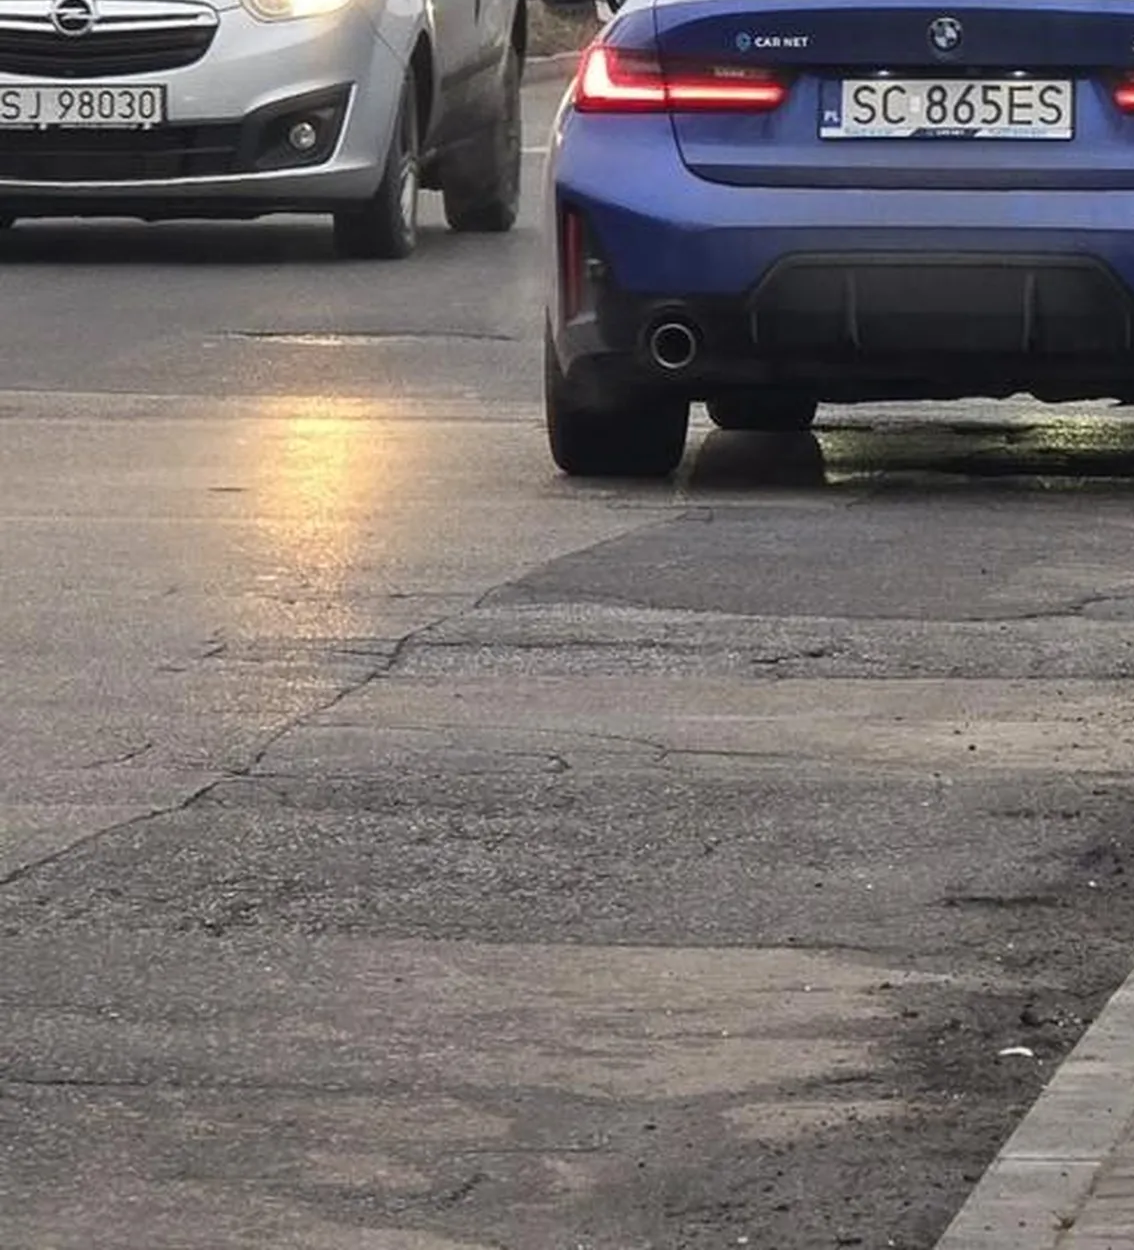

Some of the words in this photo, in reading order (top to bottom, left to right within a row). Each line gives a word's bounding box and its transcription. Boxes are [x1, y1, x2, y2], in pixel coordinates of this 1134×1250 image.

[754, 36, 780, 47] CAR
[783, 36, 808, 47] NET
[1, 91, 41, 119] SJ
[57, 90, 156, 119] 98030
[852, 84, 907, 125] SC
[925, 84, 1063, 125] 865ES
